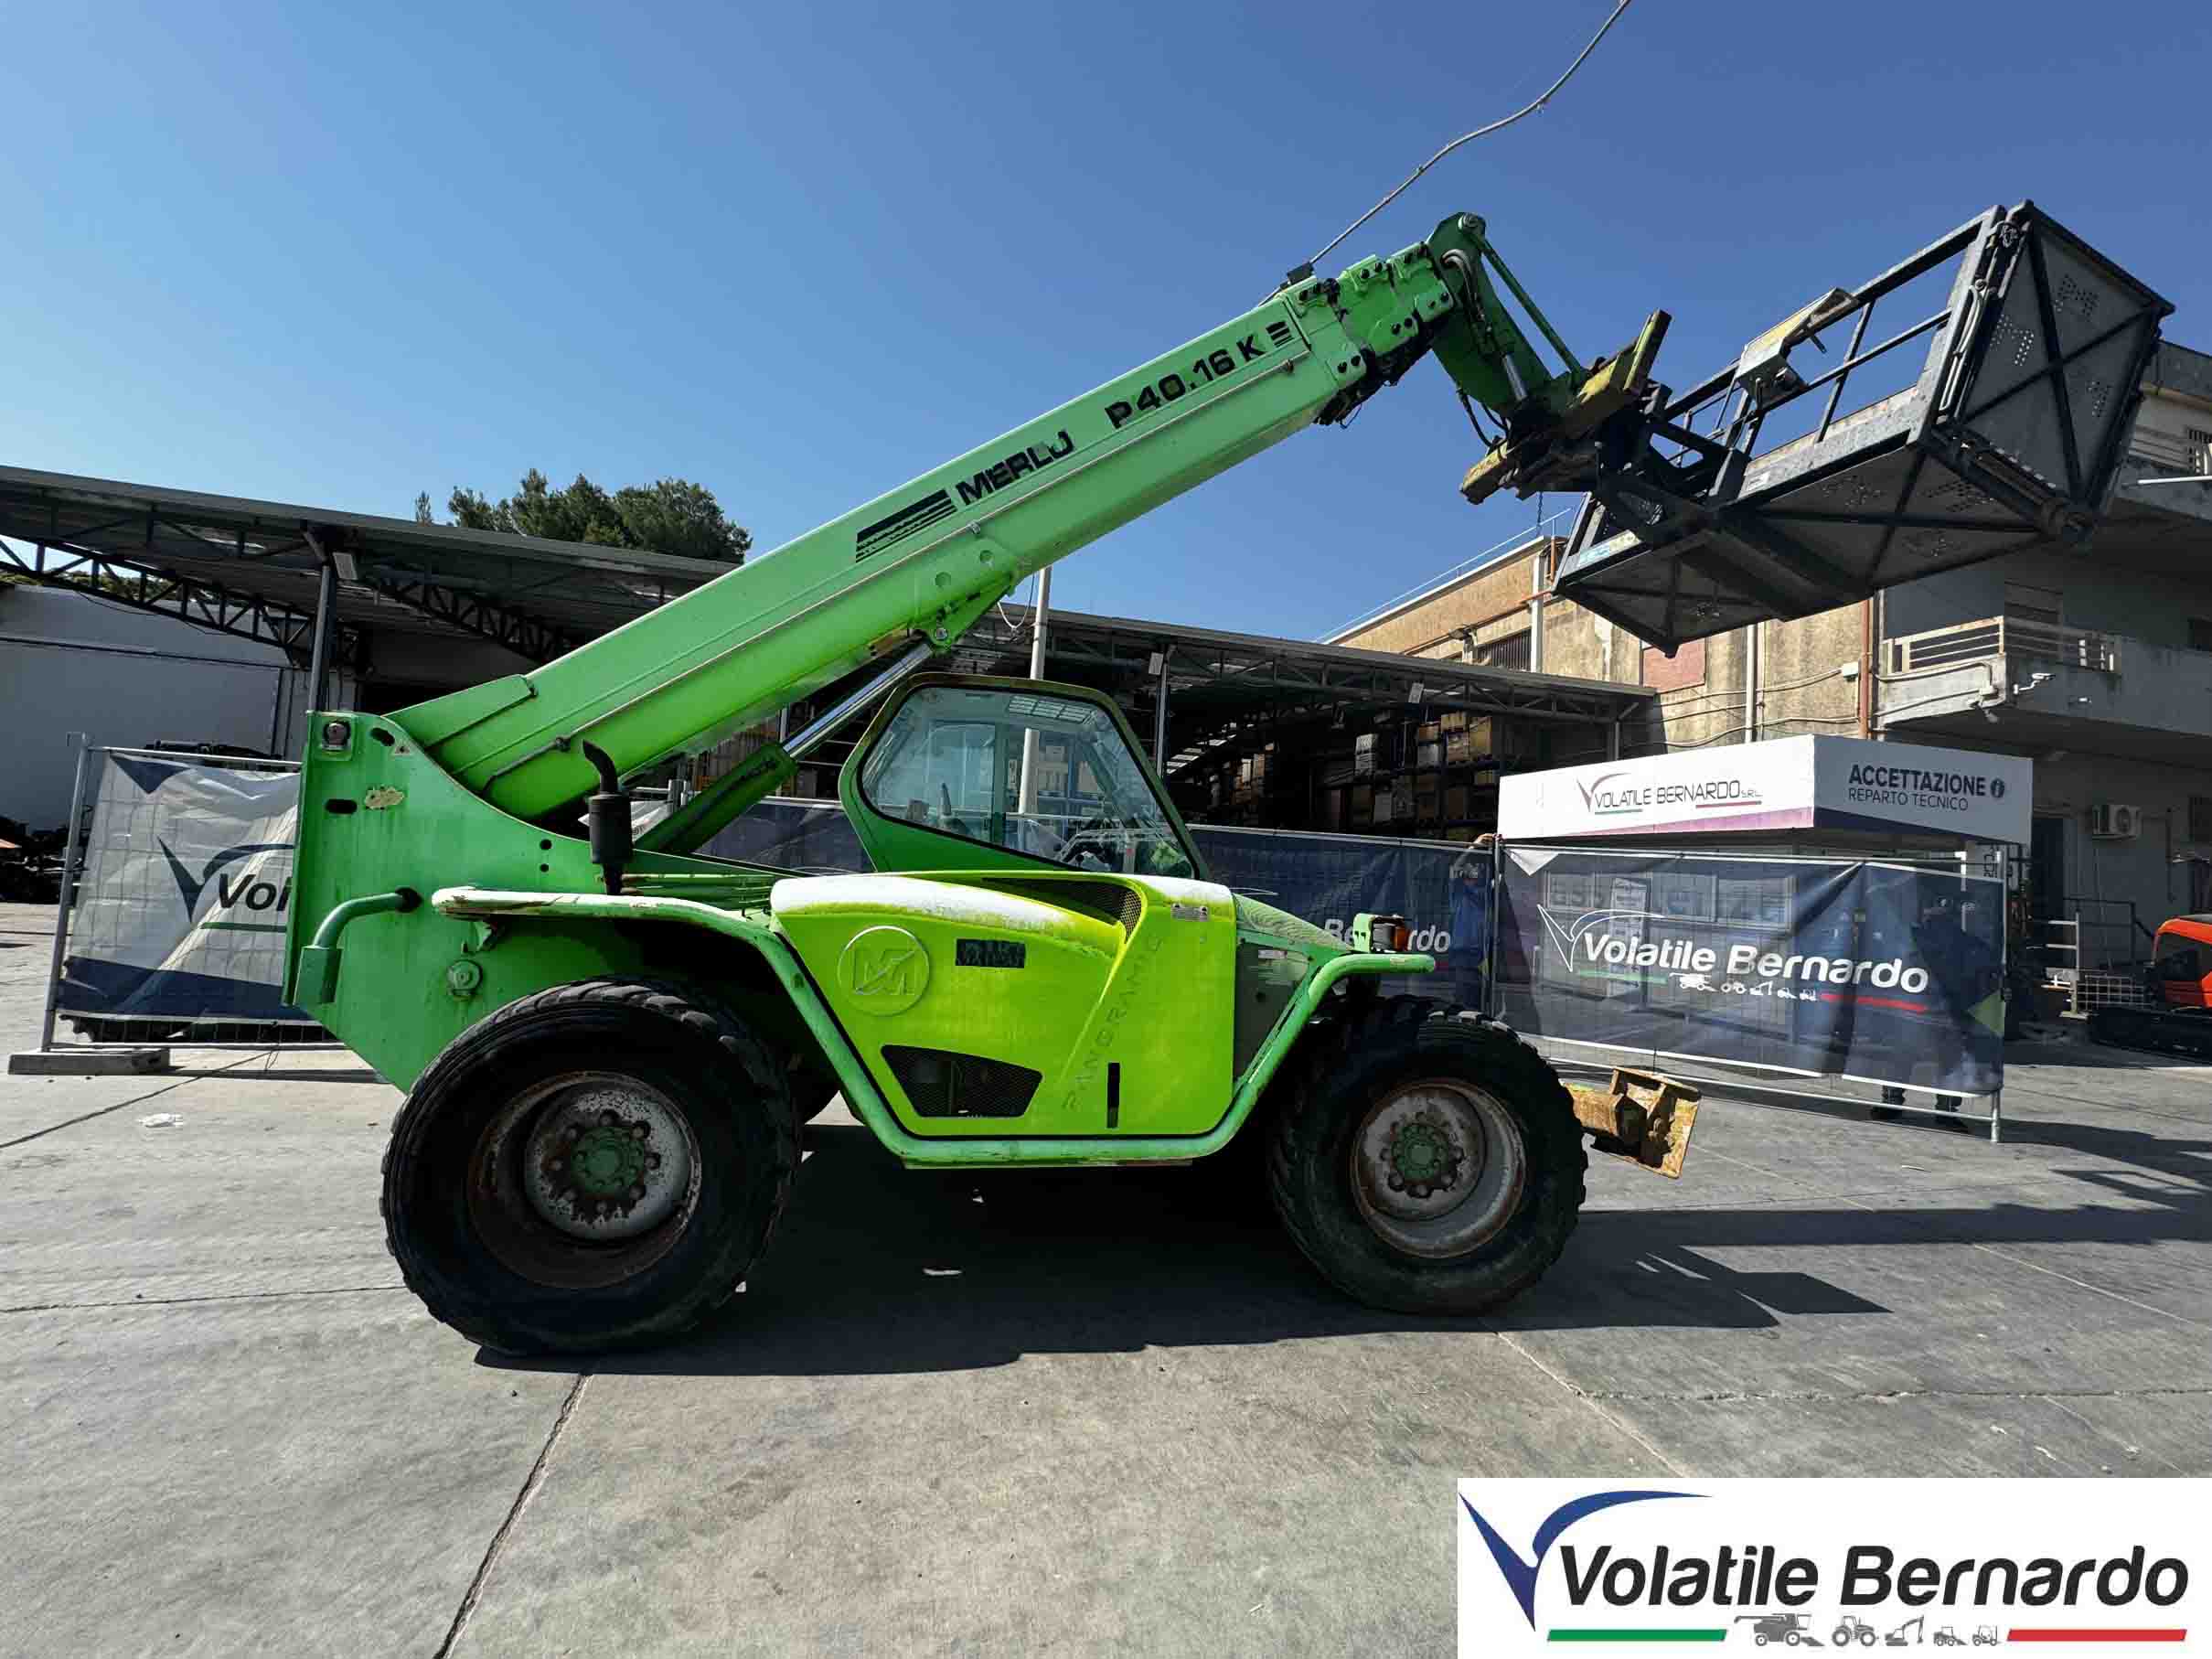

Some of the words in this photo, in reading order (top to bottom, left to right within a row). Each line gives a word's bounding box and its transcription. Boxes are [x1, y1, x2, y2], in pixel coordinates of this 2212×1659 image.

[1595, 788, 1651, 808] VOLATILE
[1656, 780, 1740, 805] BERNARDO
[1849, 765, 1986, 797] ACCETTAZIONE
[1849, 787, 1908, 806] REPARTO
[1912, 793, 1969, 811] TECNICO
[1584, 932, 1715, 972] Volatile
[1726, 945, 1929, 993] Bernardo
